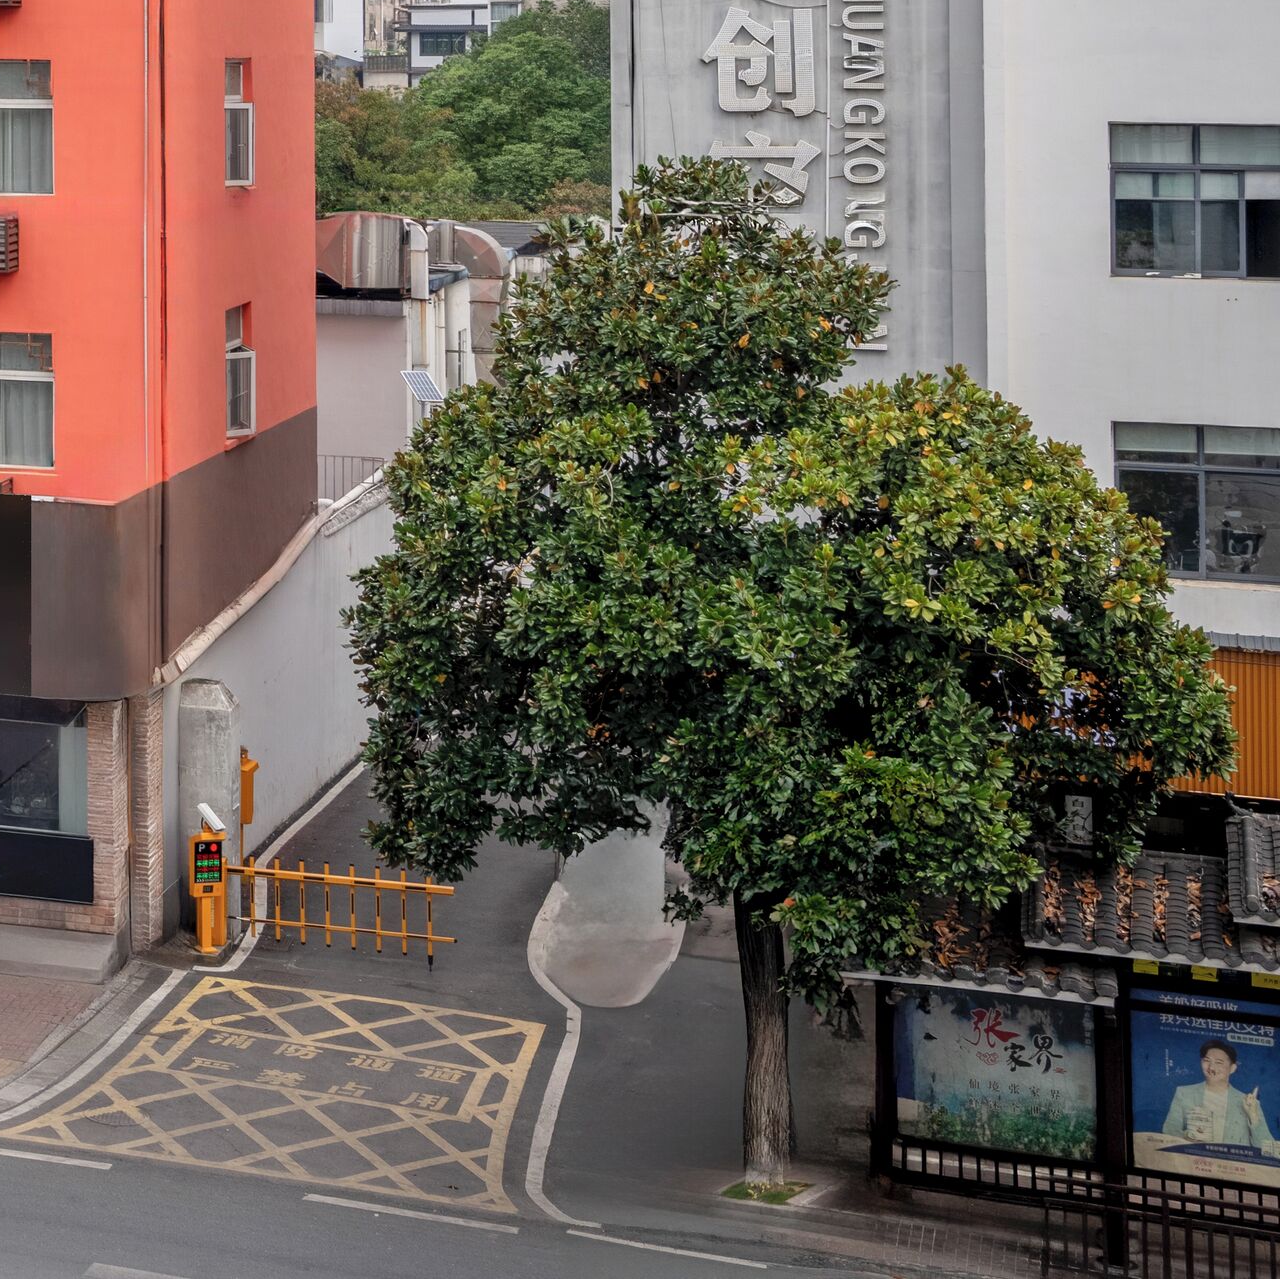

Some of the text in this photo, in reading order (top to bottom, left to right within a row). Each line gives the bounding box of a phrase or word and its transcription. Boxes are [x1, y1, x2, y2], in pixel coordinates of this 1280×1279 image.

[208, 1032, 468, 1084] 消防通道
[964, 1007, 1063, 1073] 张家界
[183, 1056, 449, 1111] 严禁占用
